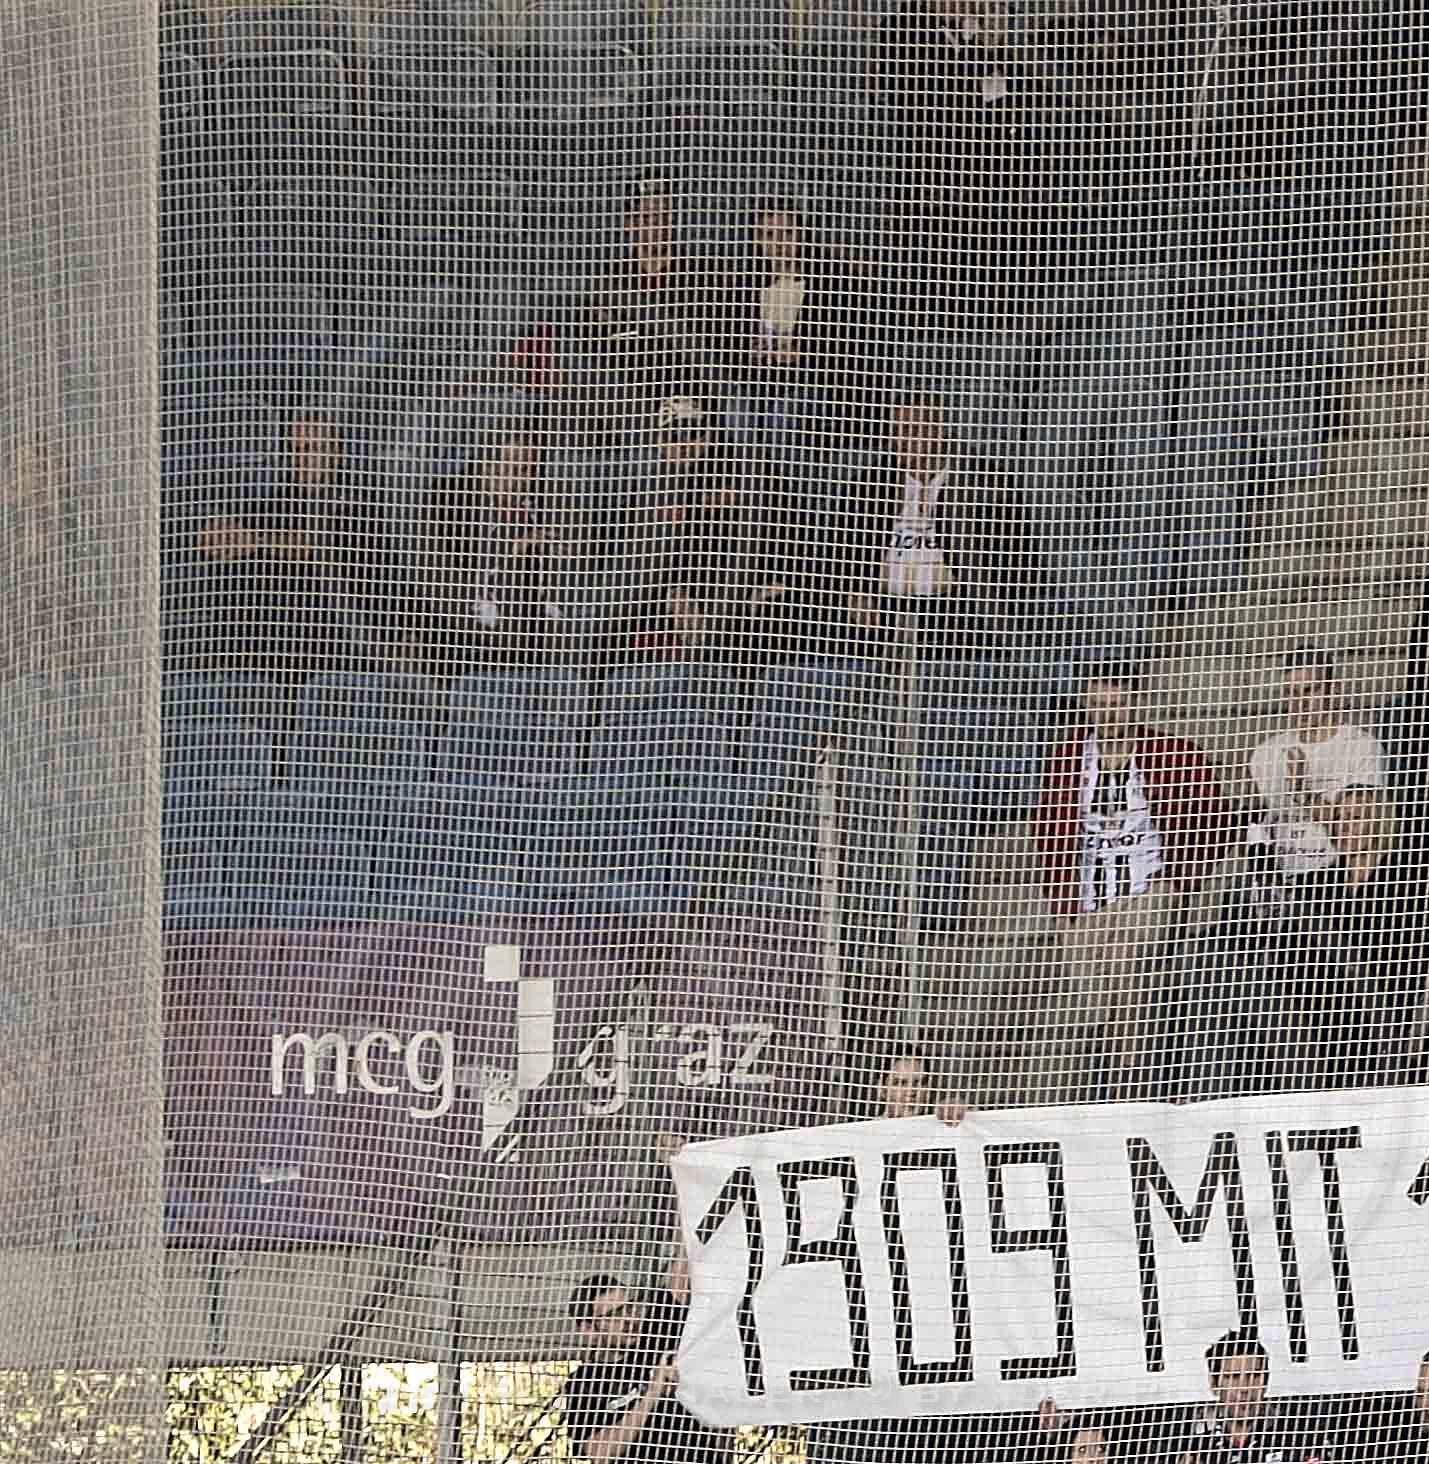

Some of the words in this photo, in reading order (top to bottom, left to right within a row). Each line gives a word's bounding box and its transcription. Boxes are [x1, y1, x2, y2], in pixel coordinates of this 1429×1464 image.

[270, 1029, 455, 1120] mcg
[696, 1142, 1077, 1396] 1909
[1127, 1125, 1363, 1372] MIT
